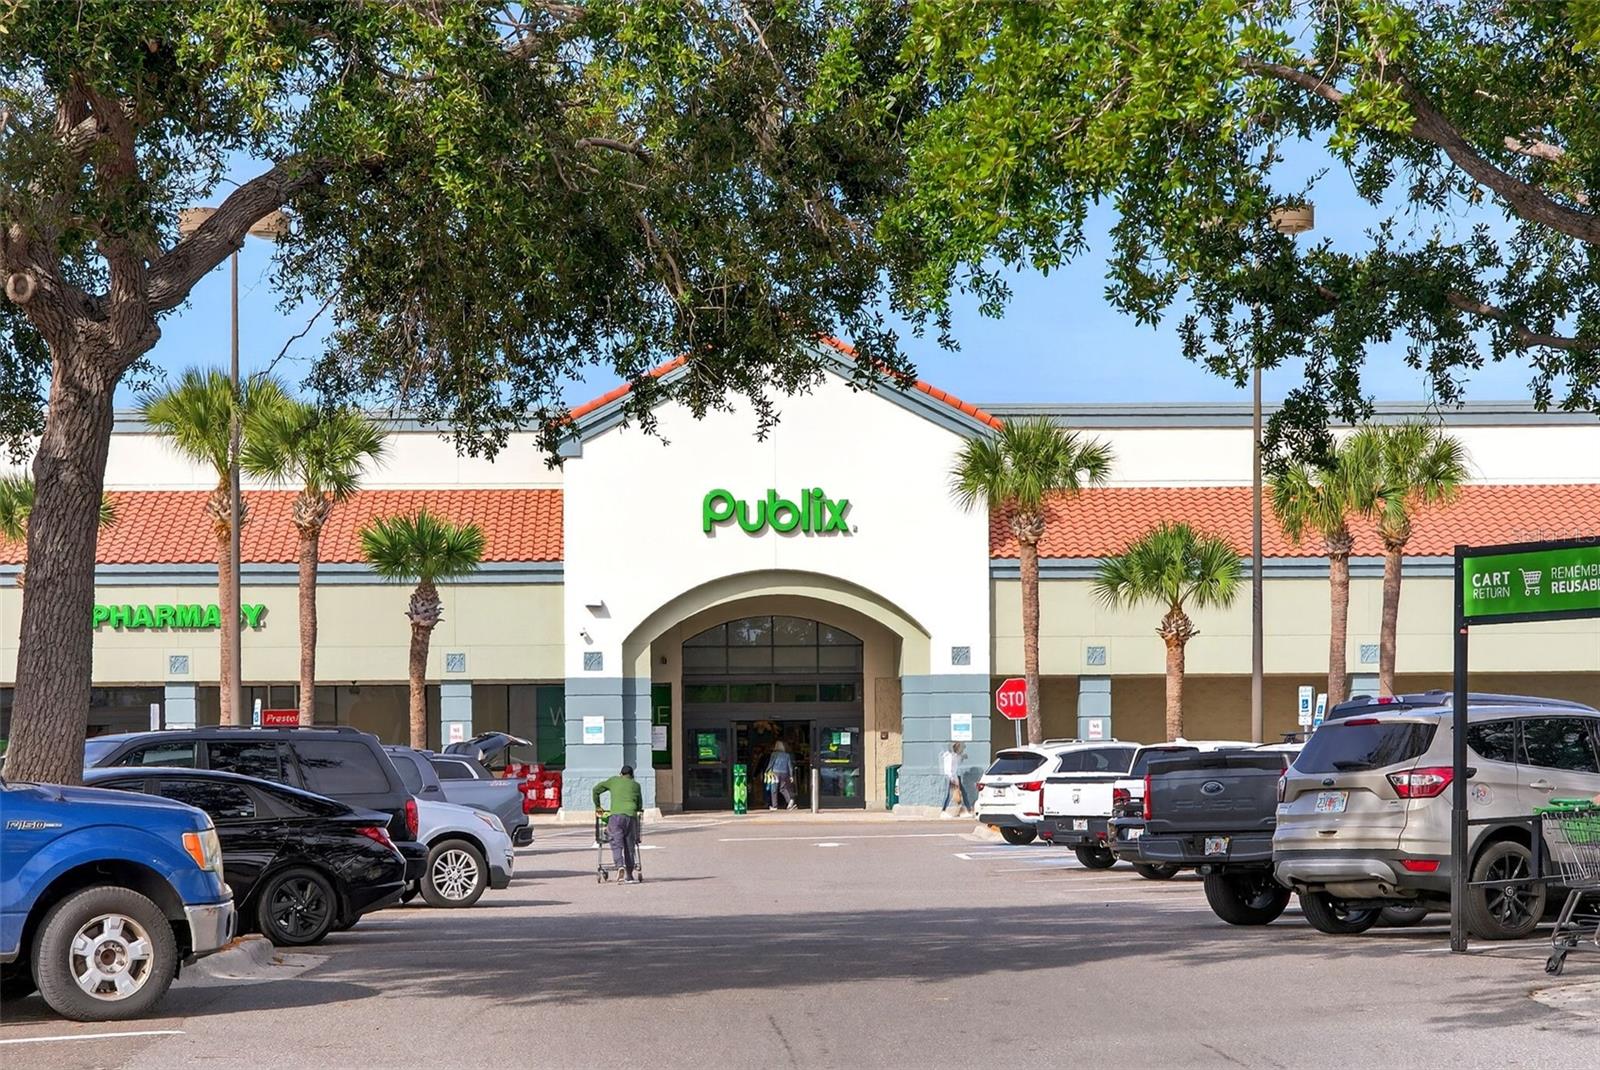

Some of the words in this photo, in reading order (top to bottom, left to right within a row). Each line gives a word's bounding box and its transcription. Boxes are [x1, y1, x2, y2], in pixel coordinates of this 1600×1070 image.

[703, 487, 849, 533] Publix
[1472, 571, 1510, 587] CART
[1473, 586, 1510, 600] RETURN
[92, 604, 265, 629] PHARMAY
[999, 691, 1026, 707] STO
